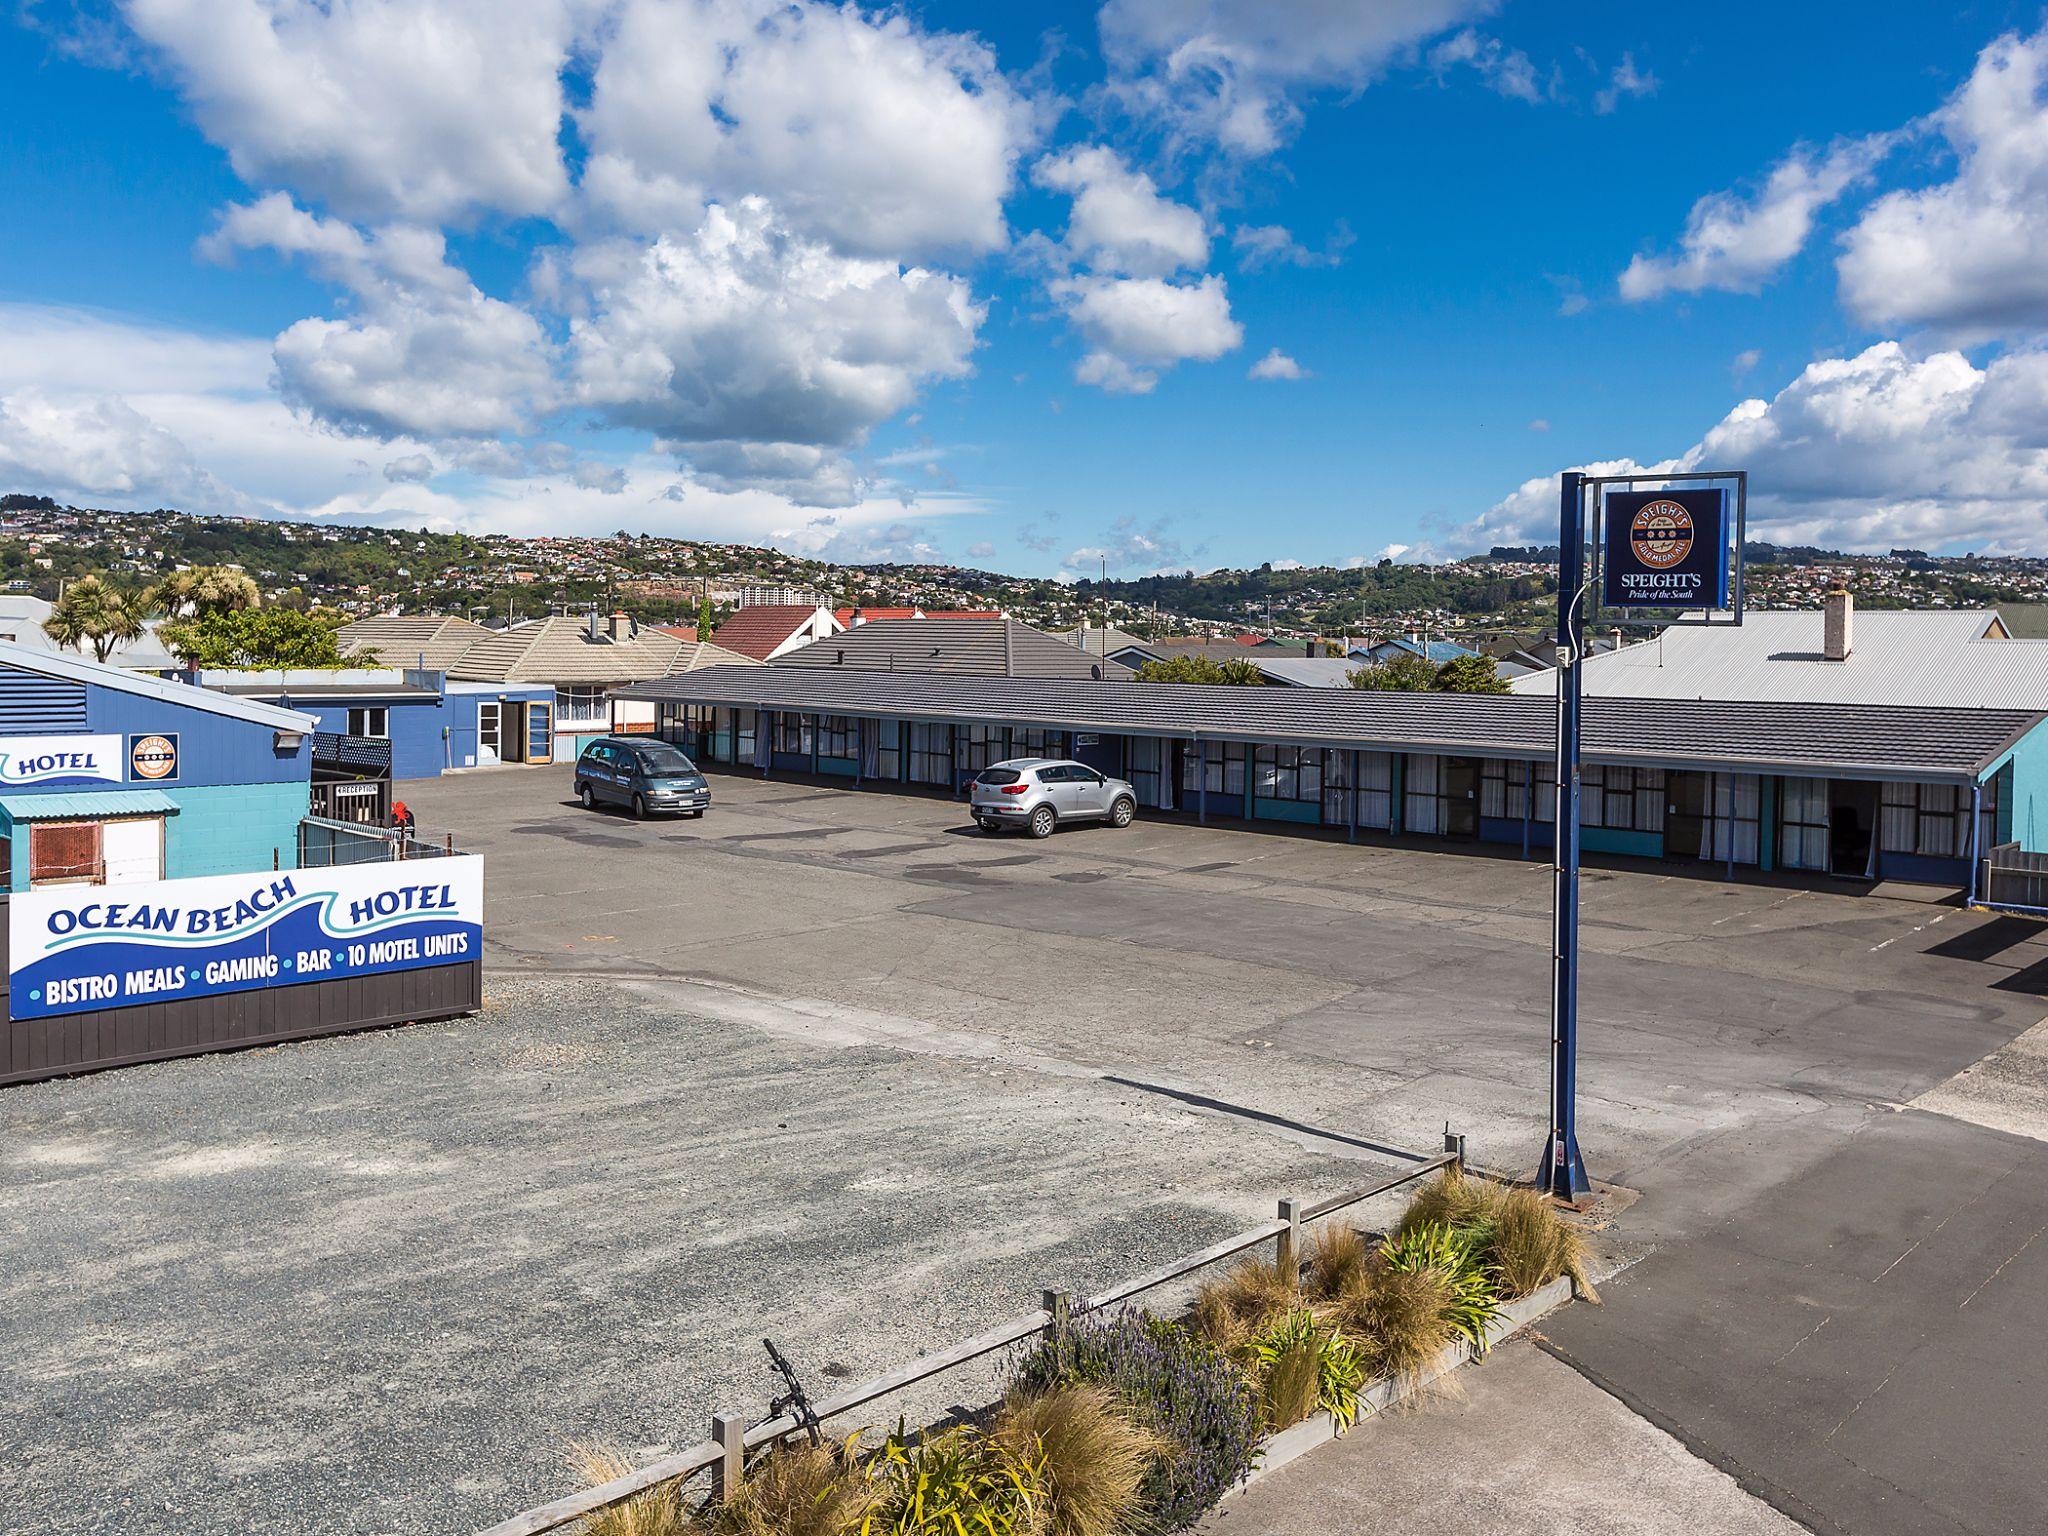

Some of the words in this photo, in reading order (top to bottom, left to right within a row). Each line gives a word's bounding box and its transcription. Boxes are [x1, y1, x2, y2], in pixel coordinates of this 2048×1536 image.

[1637, 504, 1688, 526] SPEIGHT'S
[1621, 573, 1701, 587] SPEIGHT'S
[1628, 590, 1649, 599] Pride
[1650, 590, 1658, 599] of
[1659, 590, 1670, 599] the
[1671, 590, 1693, 599] South
[19, 753, 98, 775] HOTEL
[342, 784, 377, 794] RECEPTION
[46, 903, 180, 935] OCEAN
[186, 876, 297, 934] BEACH
[350, 885, 457, 925] HOTEL
[46, 973, 118, 1006] BISTRO
[125, 966, 186, 995] MEALS
[205, 955, 278, 986] GAMING
[297, 948, 332, 973] BAR
[348, 946, 366, 967] 10
[369, 938, 420, 963] MOTEL
[424, 932, 468, 957] UNITS
